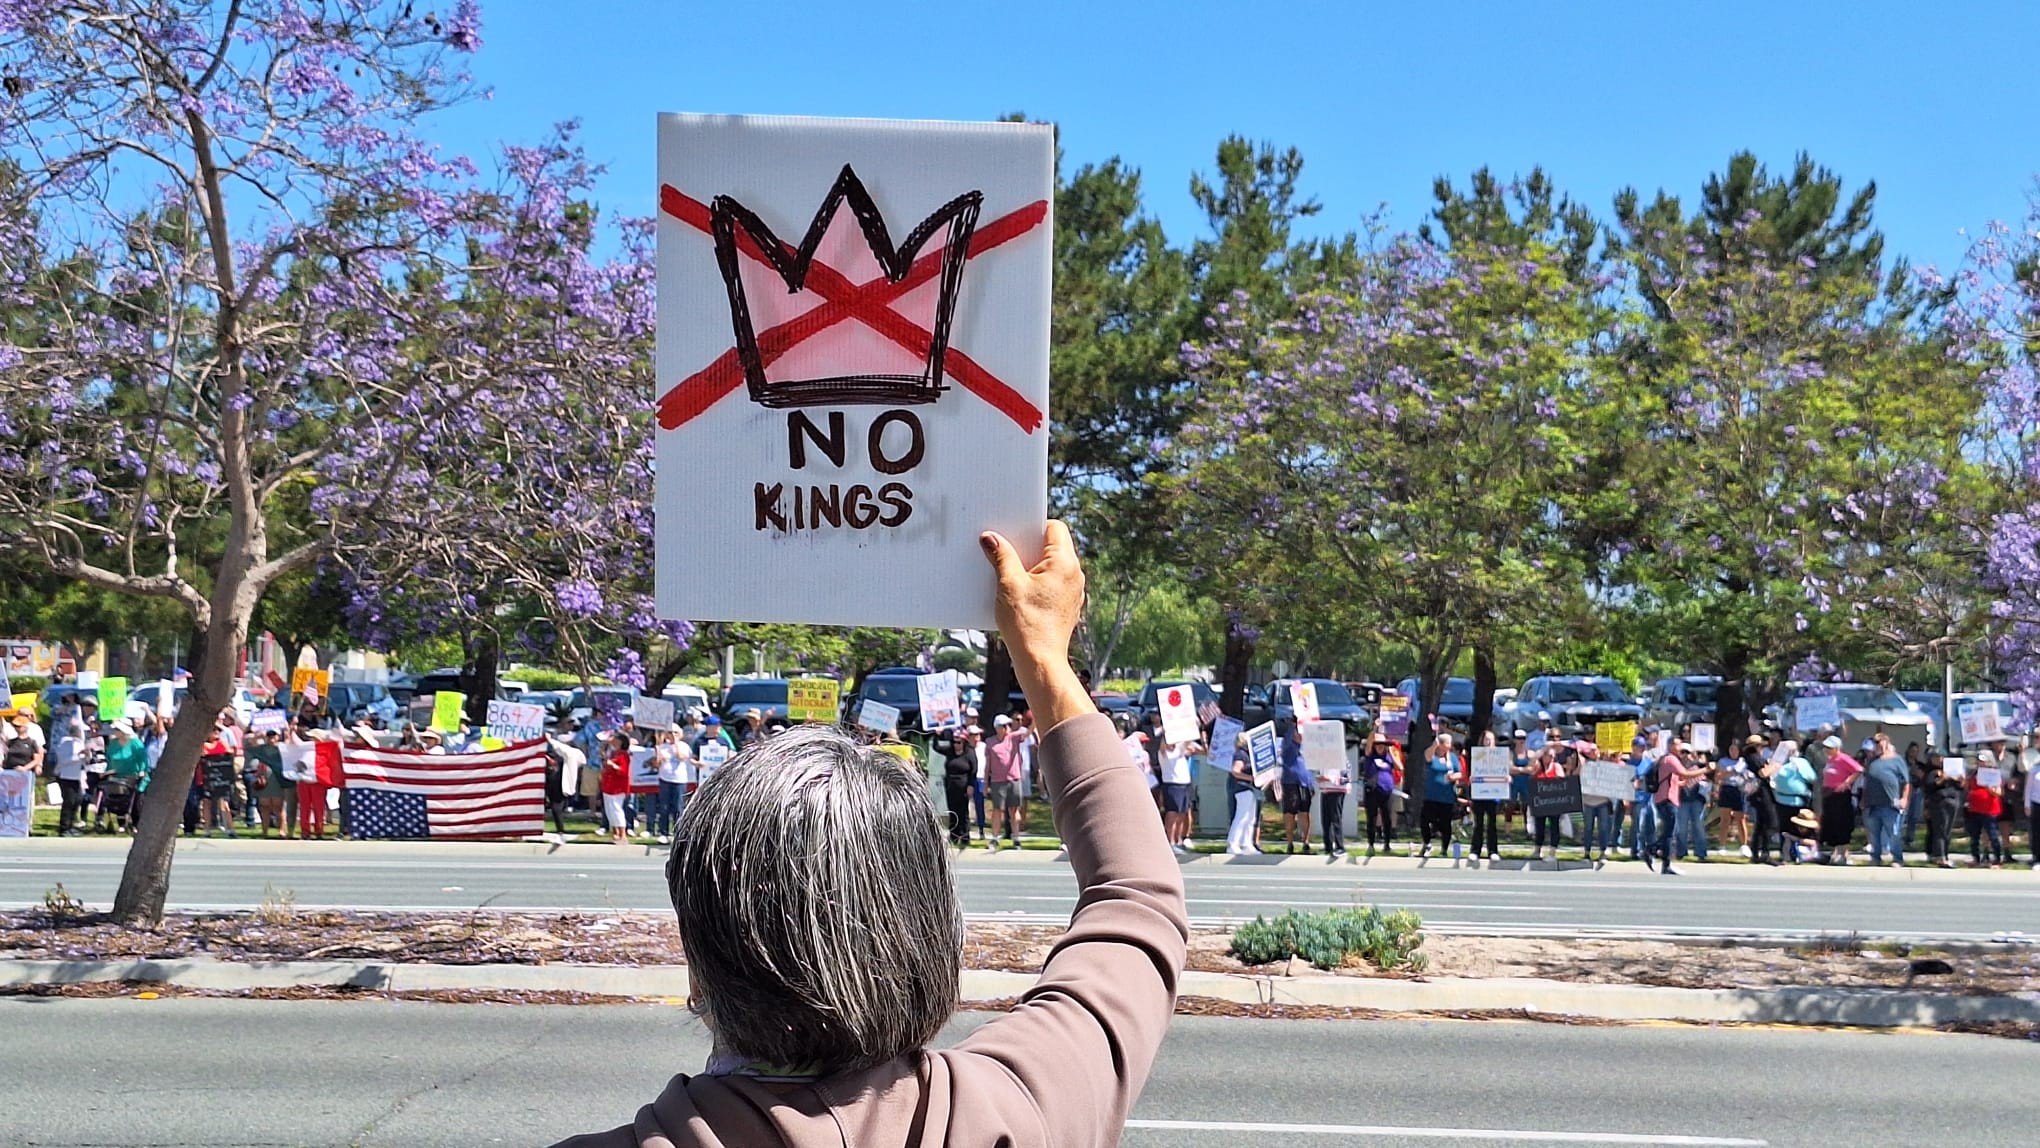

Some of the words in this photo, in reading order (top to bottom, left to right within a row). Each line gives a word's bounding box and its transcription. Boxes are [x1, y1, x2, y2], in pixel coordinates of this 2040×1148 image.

[787, 409, 926, 475] NO
[753, 482, 914, 532] KINGS
[789, 680, 837, 690] DEMOCRACY
[789, 698, 835, 709] AUTOCRACY
[486, 723, 541, 739] IMPEACH
